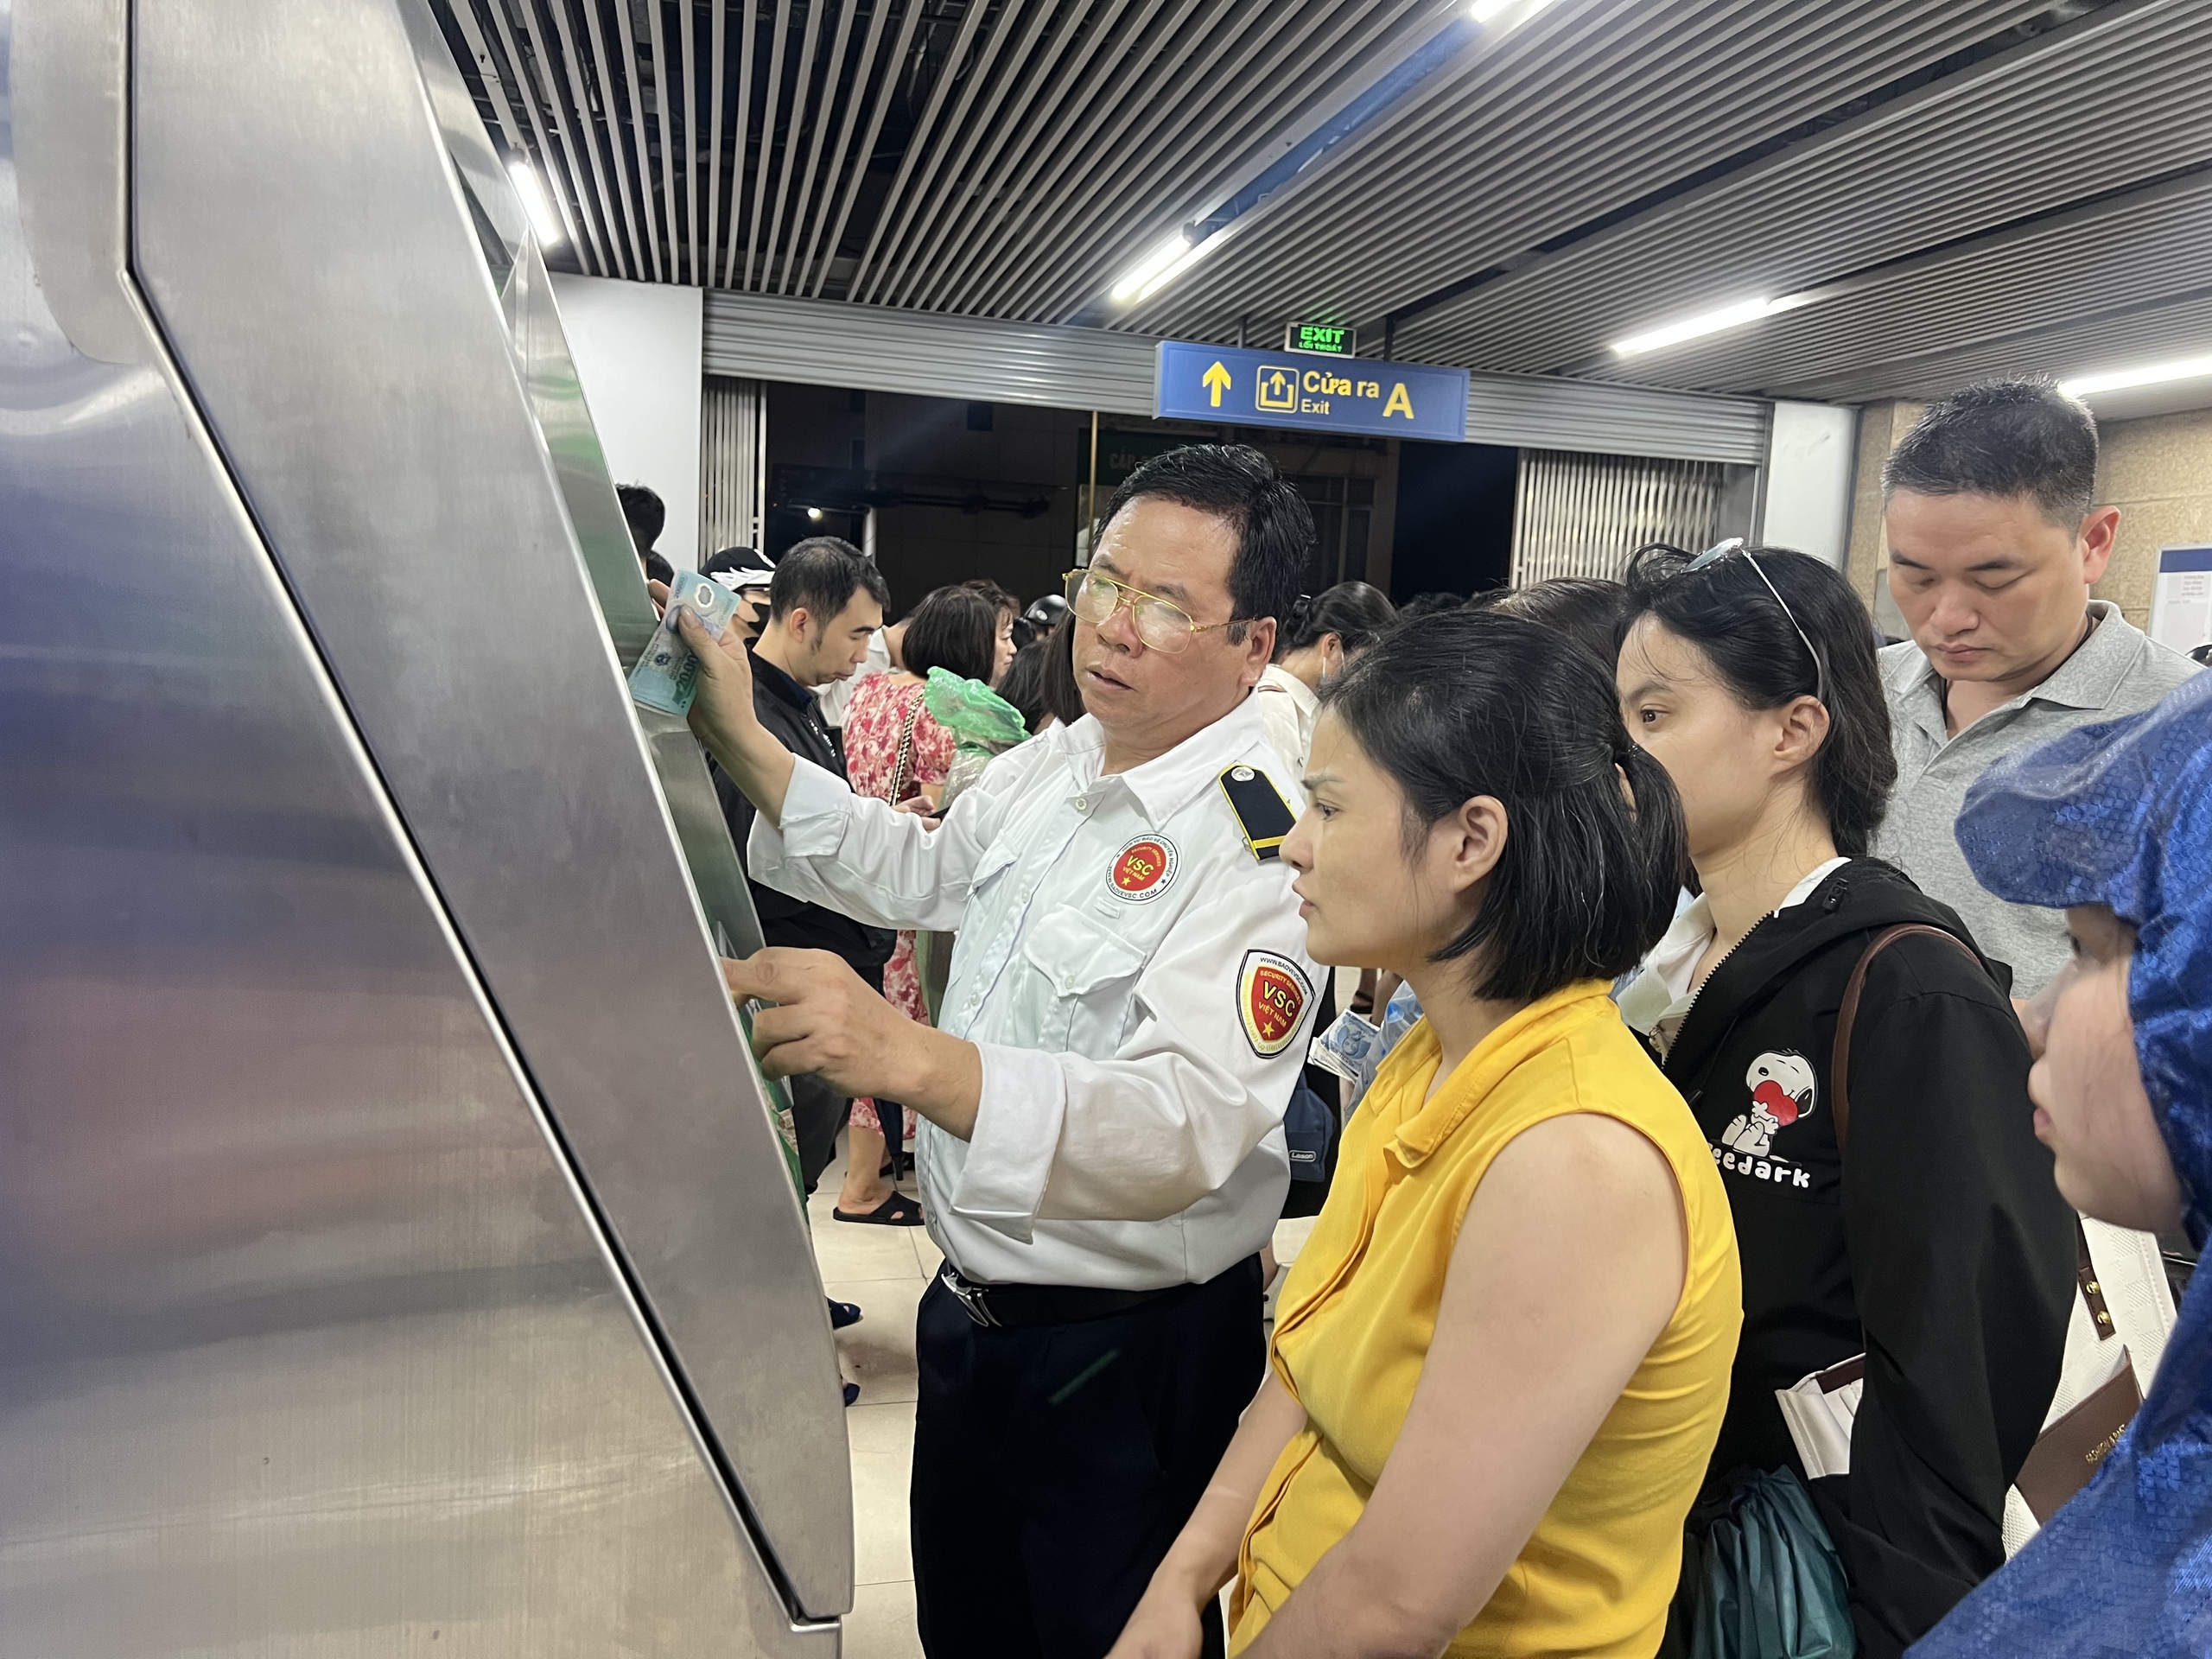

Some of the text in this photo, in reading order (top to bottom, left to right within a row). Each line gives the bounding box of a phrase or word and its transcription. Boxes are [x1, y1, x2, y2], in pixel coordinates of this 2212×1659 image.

[1300, 326, 1344, 344] EXIT
[1301, 398, 1330, 415] Exit
[1303, 371, 1414, 419] Cửa ra A
[1127, 855, 1154, 875] VSC
[1133, 872, 1146, 881] NAM
[1260, 970, 1302, 1005] SECURITY SERVICES
[1263, 981, 1295, 1018] VSC
[1258, 1001, 1287, 1027] VIỆT NAM
[1708, 1142, 1811, 1188] eedark
